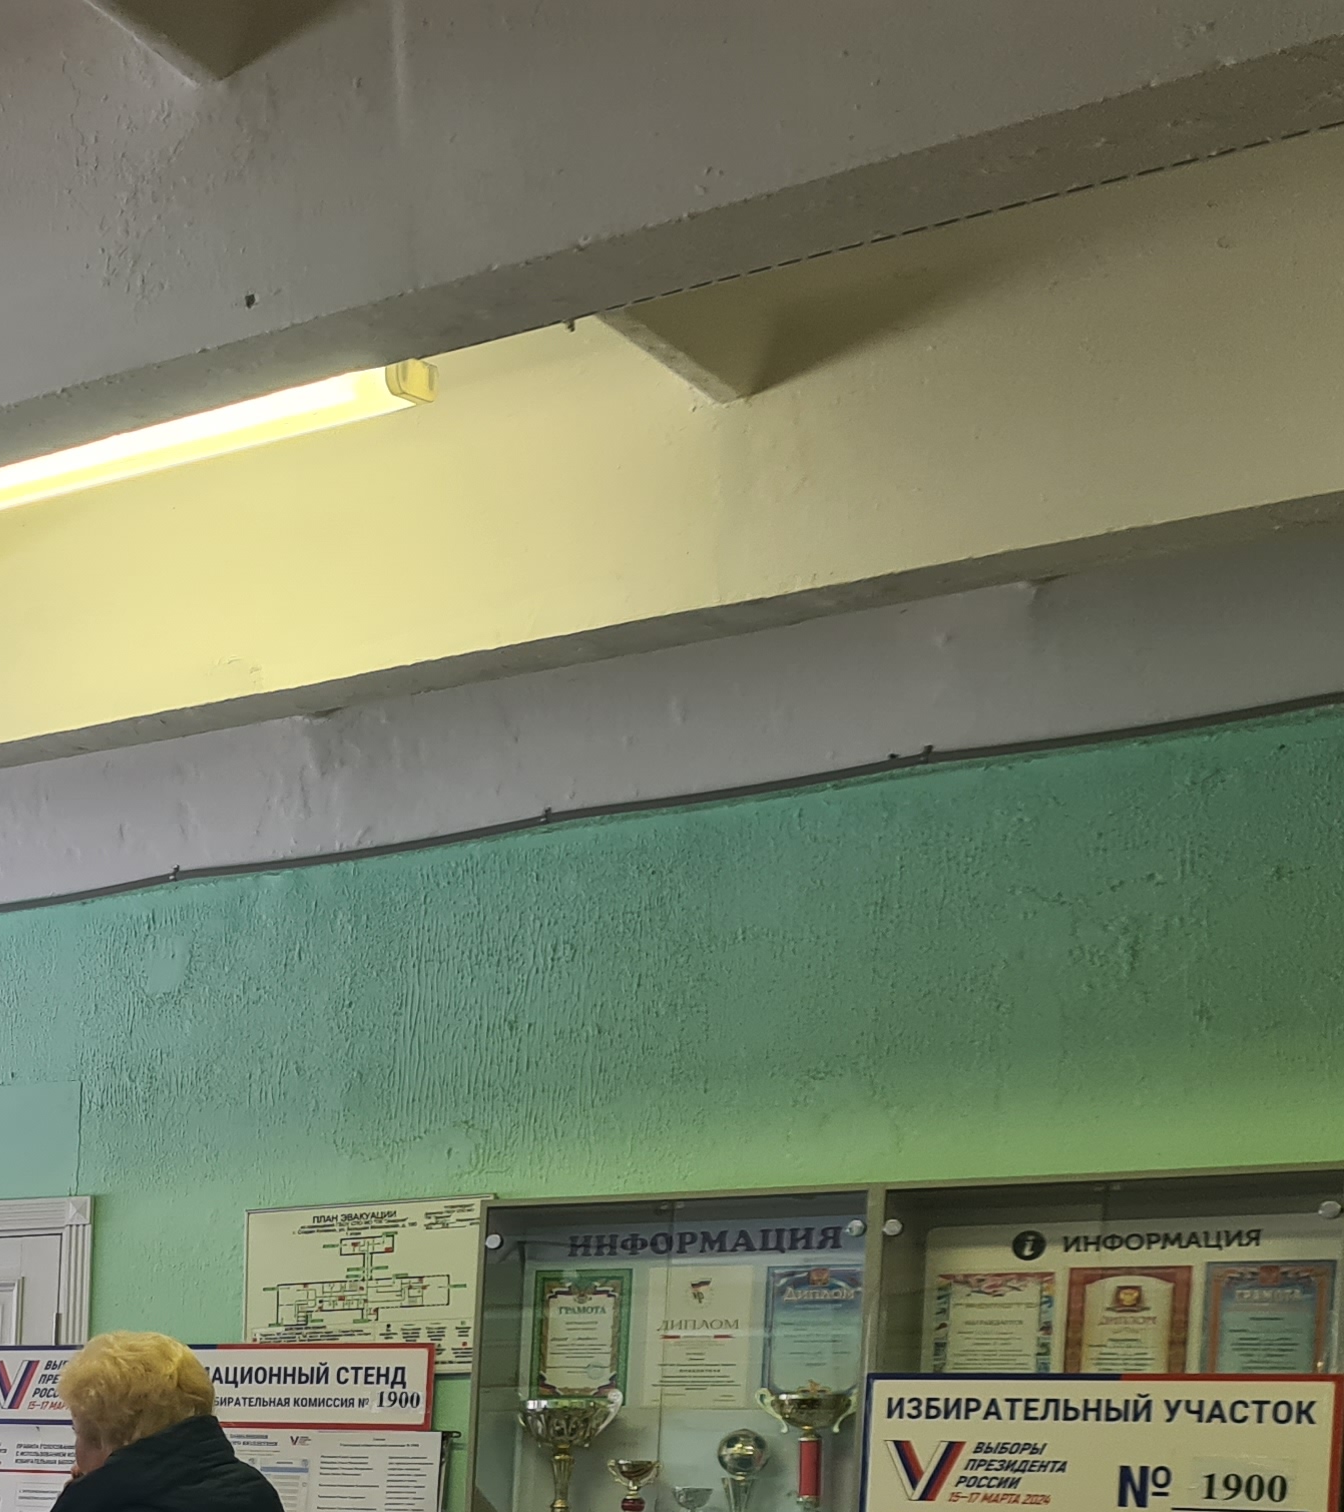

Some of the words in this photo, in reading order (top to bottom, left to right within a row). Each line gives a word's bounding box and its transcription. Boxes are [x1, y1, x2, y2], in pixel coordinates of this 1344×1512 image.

[312, 1215, 339, 1225] ПЛАН
[340, 1210, 397, 1222] ЭВАКУАЦИИ
[568, 1225, 844, 1258] ИНФОРМАЦИЯ
[1062, 1228, 1263, 1254] ИНФОРМАЦИЯ
[558, 1306, 607, 1315] ГРАМОТА
[656, 1319, 740, 1331] ДИПЛОМ
[206, 1362, 329, 1388] АЦИОННЫЙ
[336, 1366, 406, 1389] СТЕНД
[214, 1396, 291, 1408] БИРАТЕЛЬНАЯ
[293, 1397, 355, 1408] КОМИССИЯ
[376, 1391, 421, 1409] 1900
[885, 1394, 1152, 1423] ИЗБИРАТЕЛЬНЫЙ
[1164, 1399, 1317, 1425] УЧАСТОК
[972, 1442, 1048, 1455] ВЫБОРЫ
[963, 1458, 1068, 1474] ПРЕЗИДЕНТА
[954, 1475, 1022, 1489] РОССИИ
[1201, 1473, 1289, 1503] 1900
[981, 1493, 1021, 1504] МАРТА
[1021, 1493, 1052, 1505] 2024
